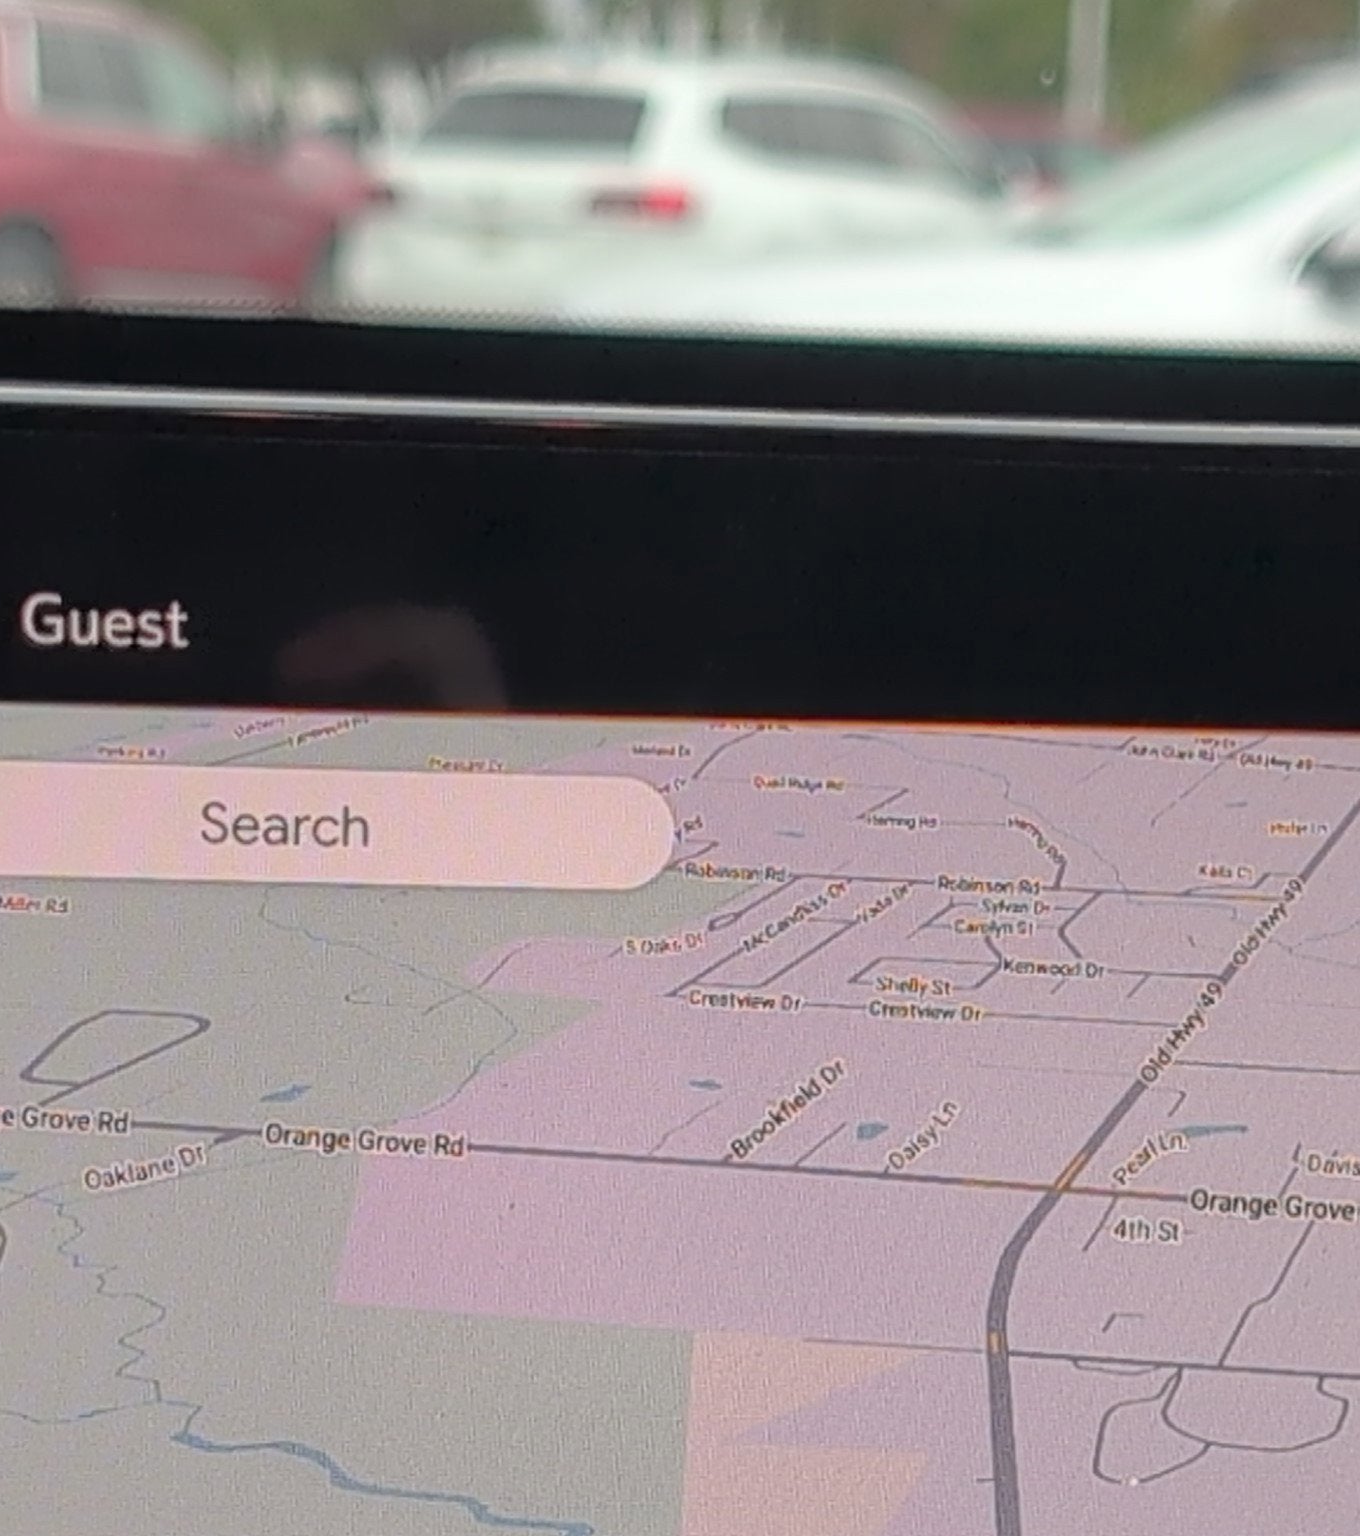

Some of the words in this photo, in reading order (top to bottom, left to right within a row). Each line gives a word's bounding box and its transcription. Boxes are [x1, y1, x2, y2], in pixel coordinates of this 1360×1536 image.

[22, 593, 188, 650] Guest
[201, 800, 369, 848] Search
[765, 865, 786, 883] Rd
[938, 876, 1013, 896] Robinson
[1018, 879, 1040, 896] Rd
[46, 896, 69, 913] Rd
[1017, 921, 1033, 936] St
[1233, 934, 1261, 966] Old
[1255, 903, 1290, 940] Hwy
[1283, 878, 1304, 902] 49
[625, 939, 637, 954] S
[1003, 957, 1081, 976] Kenwood
[1085, 961, 1104, 978] Dr
[689, 989, 776, 1009] Crestview
[780, 993, 801, 1012] Dr
[931, 978, 953, 996] St
[868, 1000, 956, 1021] Crestview
[961, 1004, 983, 1022] Dr
[1140, 1045, 1173, 1083] Old
[1166, 1007, 1207, 1050] Hwy
[1200, 981, 1224, 1008] 49
[21, 1105, 91, 1132] Grove
[97, 1110, 129, 1134] Rd
[730, 1077, 822, 1160] Brookfield
[820, 1060, 845, 1085] Dr
[265, 1122, 350, 1152] Orange
[357, 1128, 427, 1154] Grove
[434, 1133, 464, 1157] Rd
[888, 1127, 940, 1171] Daisy
[931, 1101, 958, 1128] Ln
[84, 1155, 176, 1190] Oaklane
[177, 1145, 206, 1170] Dr
[1112, 1138, 1159, 1186] Pearl
[1159, 1131, 1185, 1152] Ln
[1190, 1187, 1278, 1220] Orange
[1285, 1193, 1356, 1219] Grove
[1112, 1218, 1151, 1240] 4th
[1157, 1220, 1180, 1242] St
